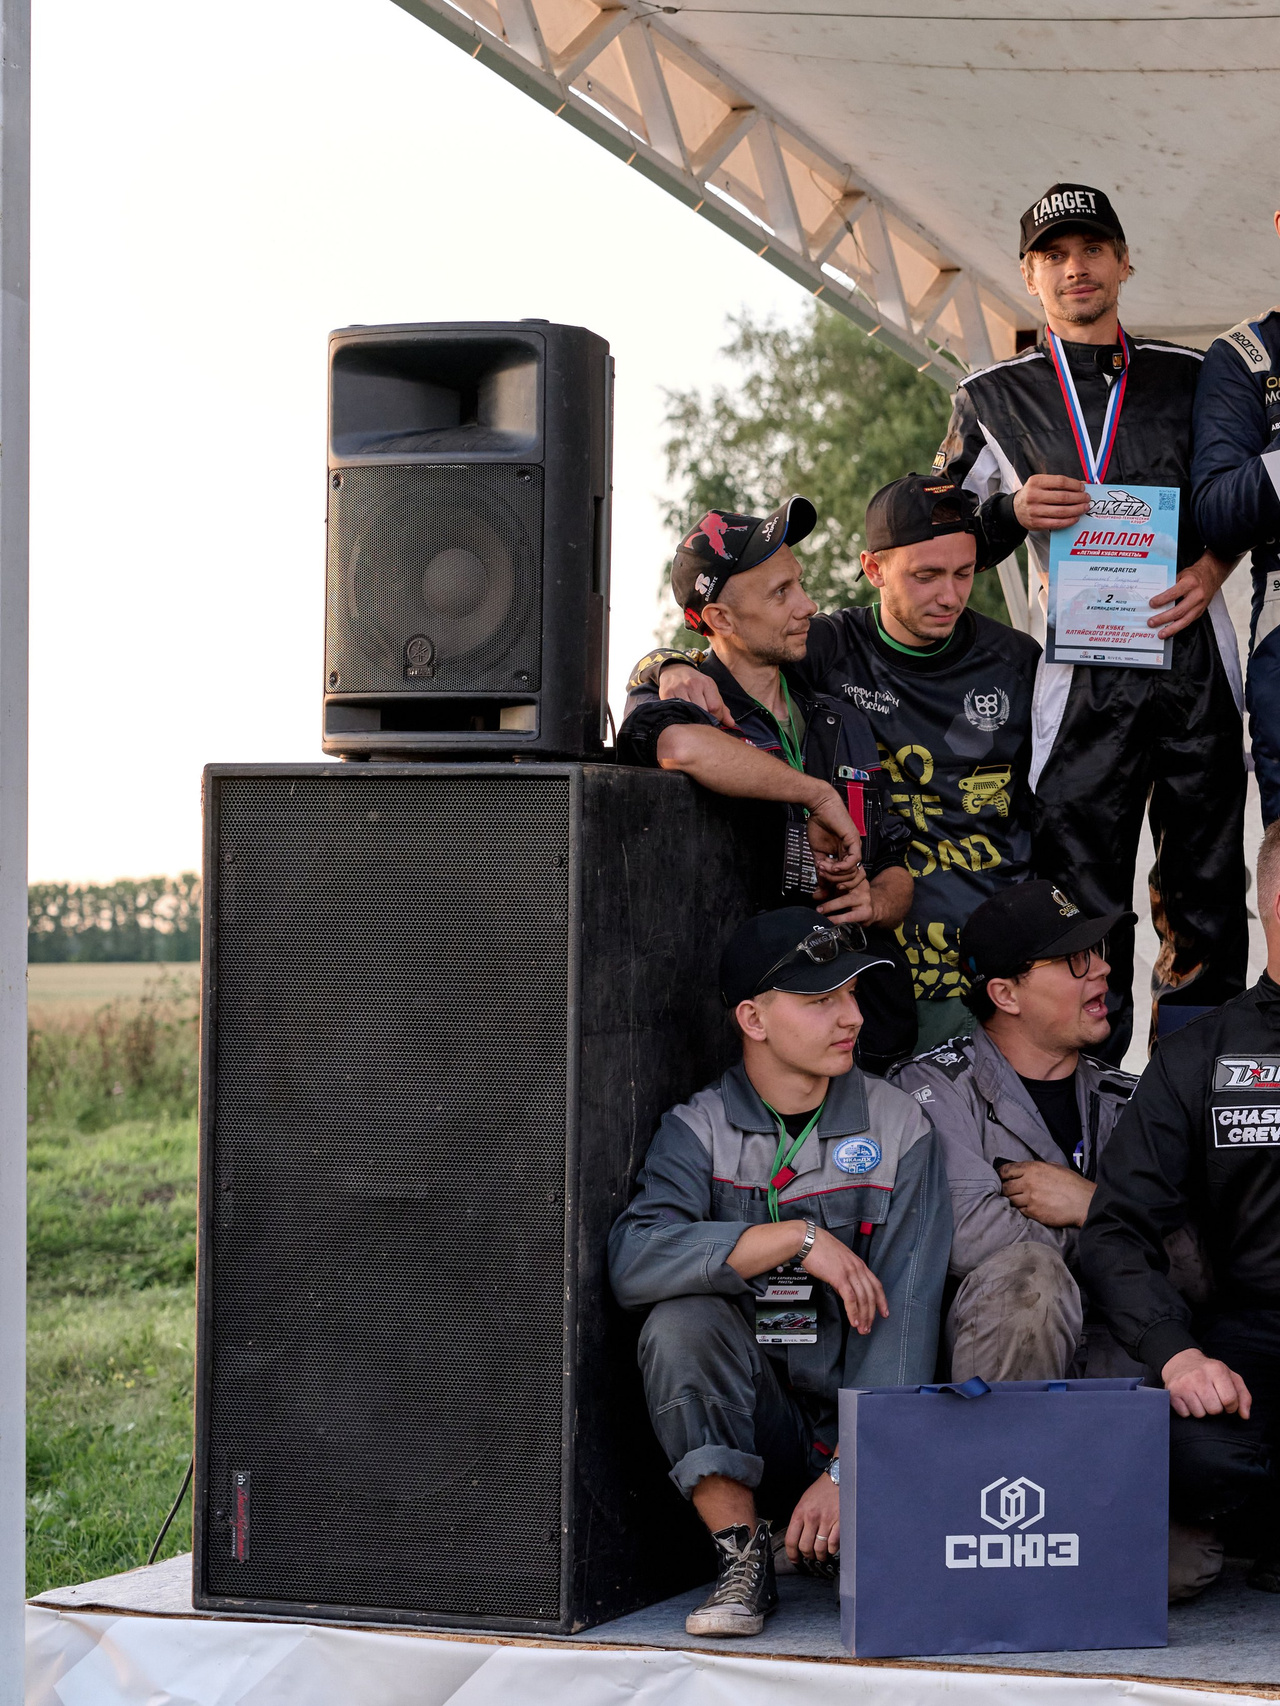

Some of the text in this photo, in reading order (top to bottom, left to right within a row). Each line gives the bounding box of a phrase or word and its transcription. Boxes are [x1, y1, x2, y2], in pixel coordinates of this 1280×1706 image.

[1033, 191, 1096, 221] TARGET
[1034, 210, 1065, 227] ENERGY
[1229, 331, 1264, 365] sparco
[1073, 531, 1155, 547] ДИПЛОМ
[1105, 594, 1114, 604] 2
[1065, 629, 1104, 637] АЛТАЙСКОГО
[904, 834, 1002, 878] OAD
[945, 1535, 1079, 1568] СОЮЗ
